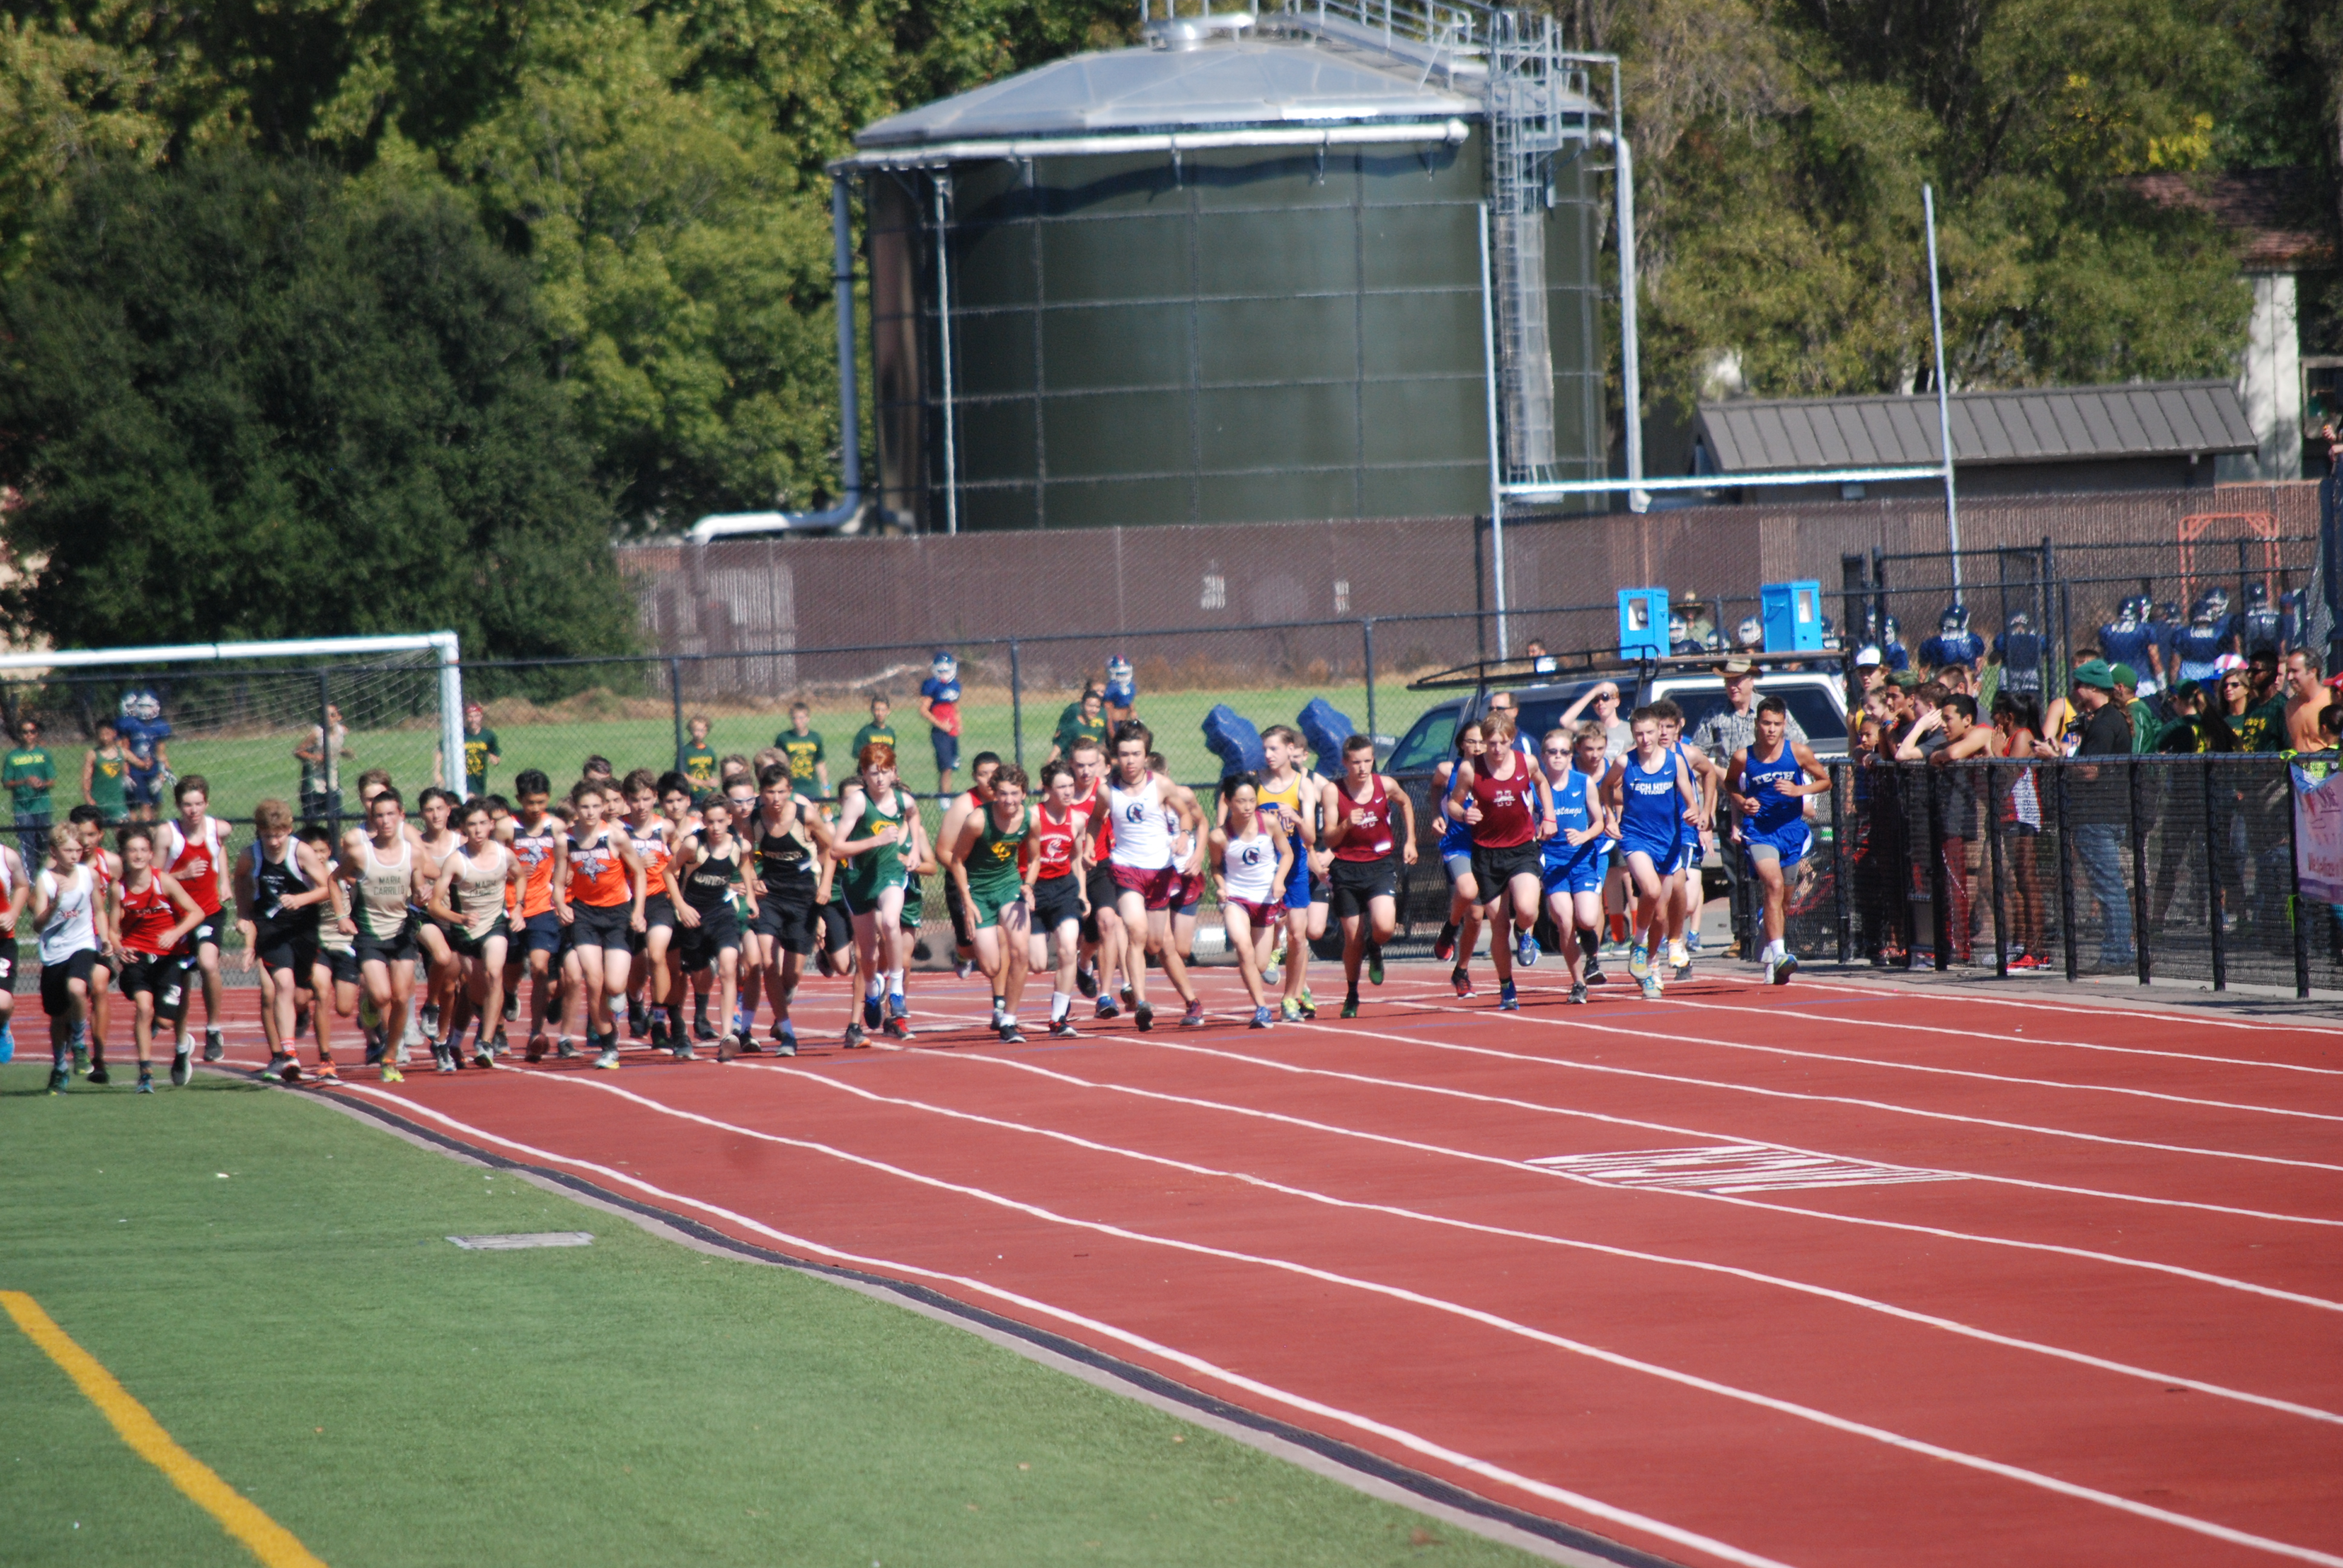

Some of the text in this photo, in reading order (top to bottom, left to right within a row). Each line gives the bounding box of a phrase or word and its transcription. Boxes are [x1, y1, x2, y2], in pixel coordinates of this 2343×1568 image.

[1752, 771, 1795, 785] TECH
[1630, 781, 1674, 791] TECH HIGH
[379, 875, 401, 884] MARIA
[373, 886, 405, 895] CARRILLO
